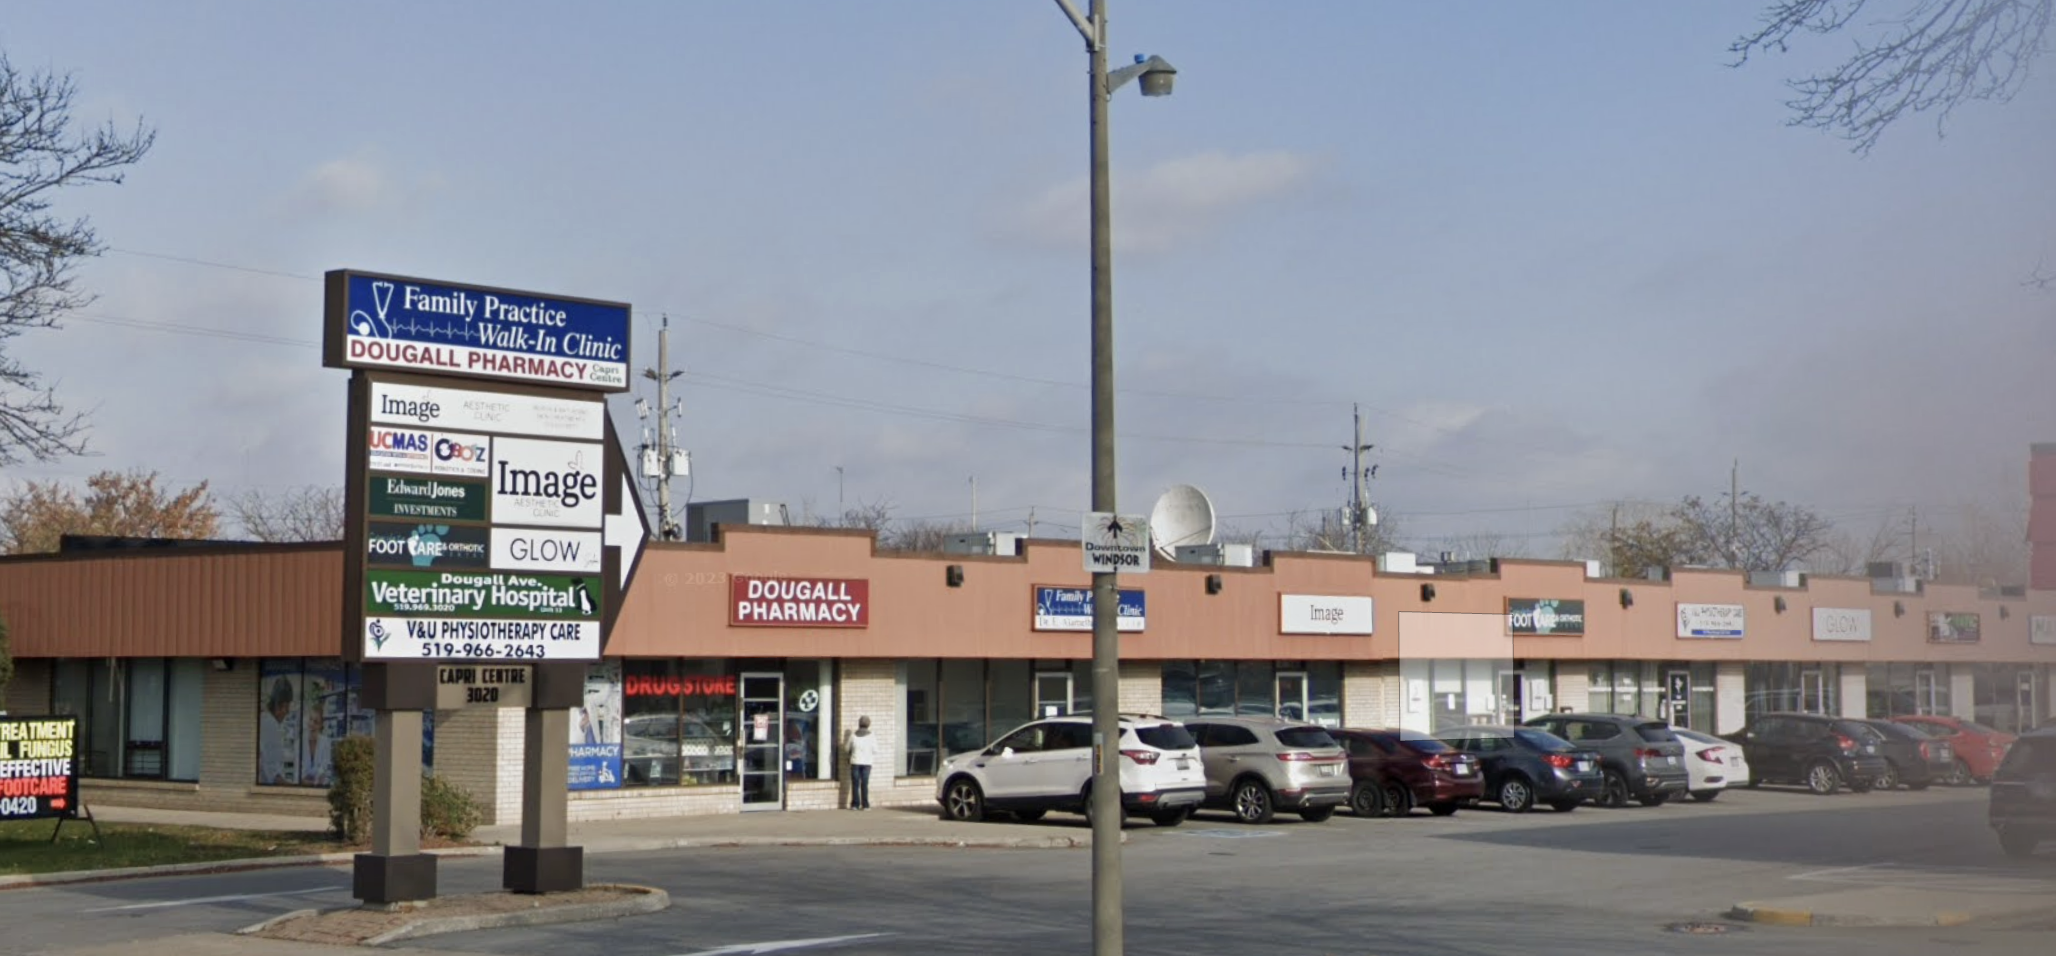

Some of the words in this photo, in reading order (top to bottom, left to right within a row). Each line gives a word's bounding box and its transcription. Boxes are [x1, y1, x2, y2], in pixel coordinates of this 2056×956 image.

[404, 286, 478, 321] Family
[484, 296, 566, 327] Practice
[478, 322, 557, 353] Walk-In
[563, 332, 622, 360] Clinic
[351, 339, 460, 368] DOUGALL
[468, 351, 586, 380] PHARMACY
[592, 364, 619, 375] Capri
[589, 373, 622, 384] Centre
[381, 394, 440, 422] Image
[463, 400, 510, 412] AESTHETIC
[474, 412, 502, 423] CLINIC
[369, 430, 428, 452] UCMAS
[497, 460, 597, 507] Image
[394, 503, 458, 518] INVESTMENTS
[514, 498, 560, 508] AESTHETIC
[533, 508, 560, 518] CLINIC
[368, 538, 406, 555] FOOT
[442, 542, 448, 551] &
[448, 542, 485, 553] ORTHOTIC
[510, 537, 580, 562] GLOW
[1085, 542, 1146, 552] Downtown
[1092, 553, 1140, 566] WINDSOR
[441, 573, 504, 587] Dougall
[508, 574, 542, 587] Ave.
[371, 581, 486, 610] Veterinary
[491, 585, 576, 611] Hospital
[748, 580, 852, 600] DOUGALL
[1055, 590, 1085, 604] Family
[393, 603, 455, 612] 519.969.3020
[738, 602, 861, 622] PHARMACY
[1117, 604, 1142, 616] Clinic
[1310, 604, 1344, 625] Image
[1508, 613, 1533, 627] FOOT
[1826, 615, 1858, 634] GLOW
[407, 620, 436, 640] V&U
[442, 621, 547, 640] PHYSIOTHERAPY
[550, 623, 580, 640] CARE
[422, 643, 545, 658] 519-966-2643
[440, 668, 476, 684] CAPRI
[482, 668, 525, 684] CENTRE
[625, 674, 681, 696] DRUG
[683, 674, 736, 695] STORE
[467, 687, 498, 702] 3020
[20, 740, 73, 758] FUNGUS
[568, 746, 620, 758] HARMACY
[0, 758, 71, 778] EFFECTIVE
